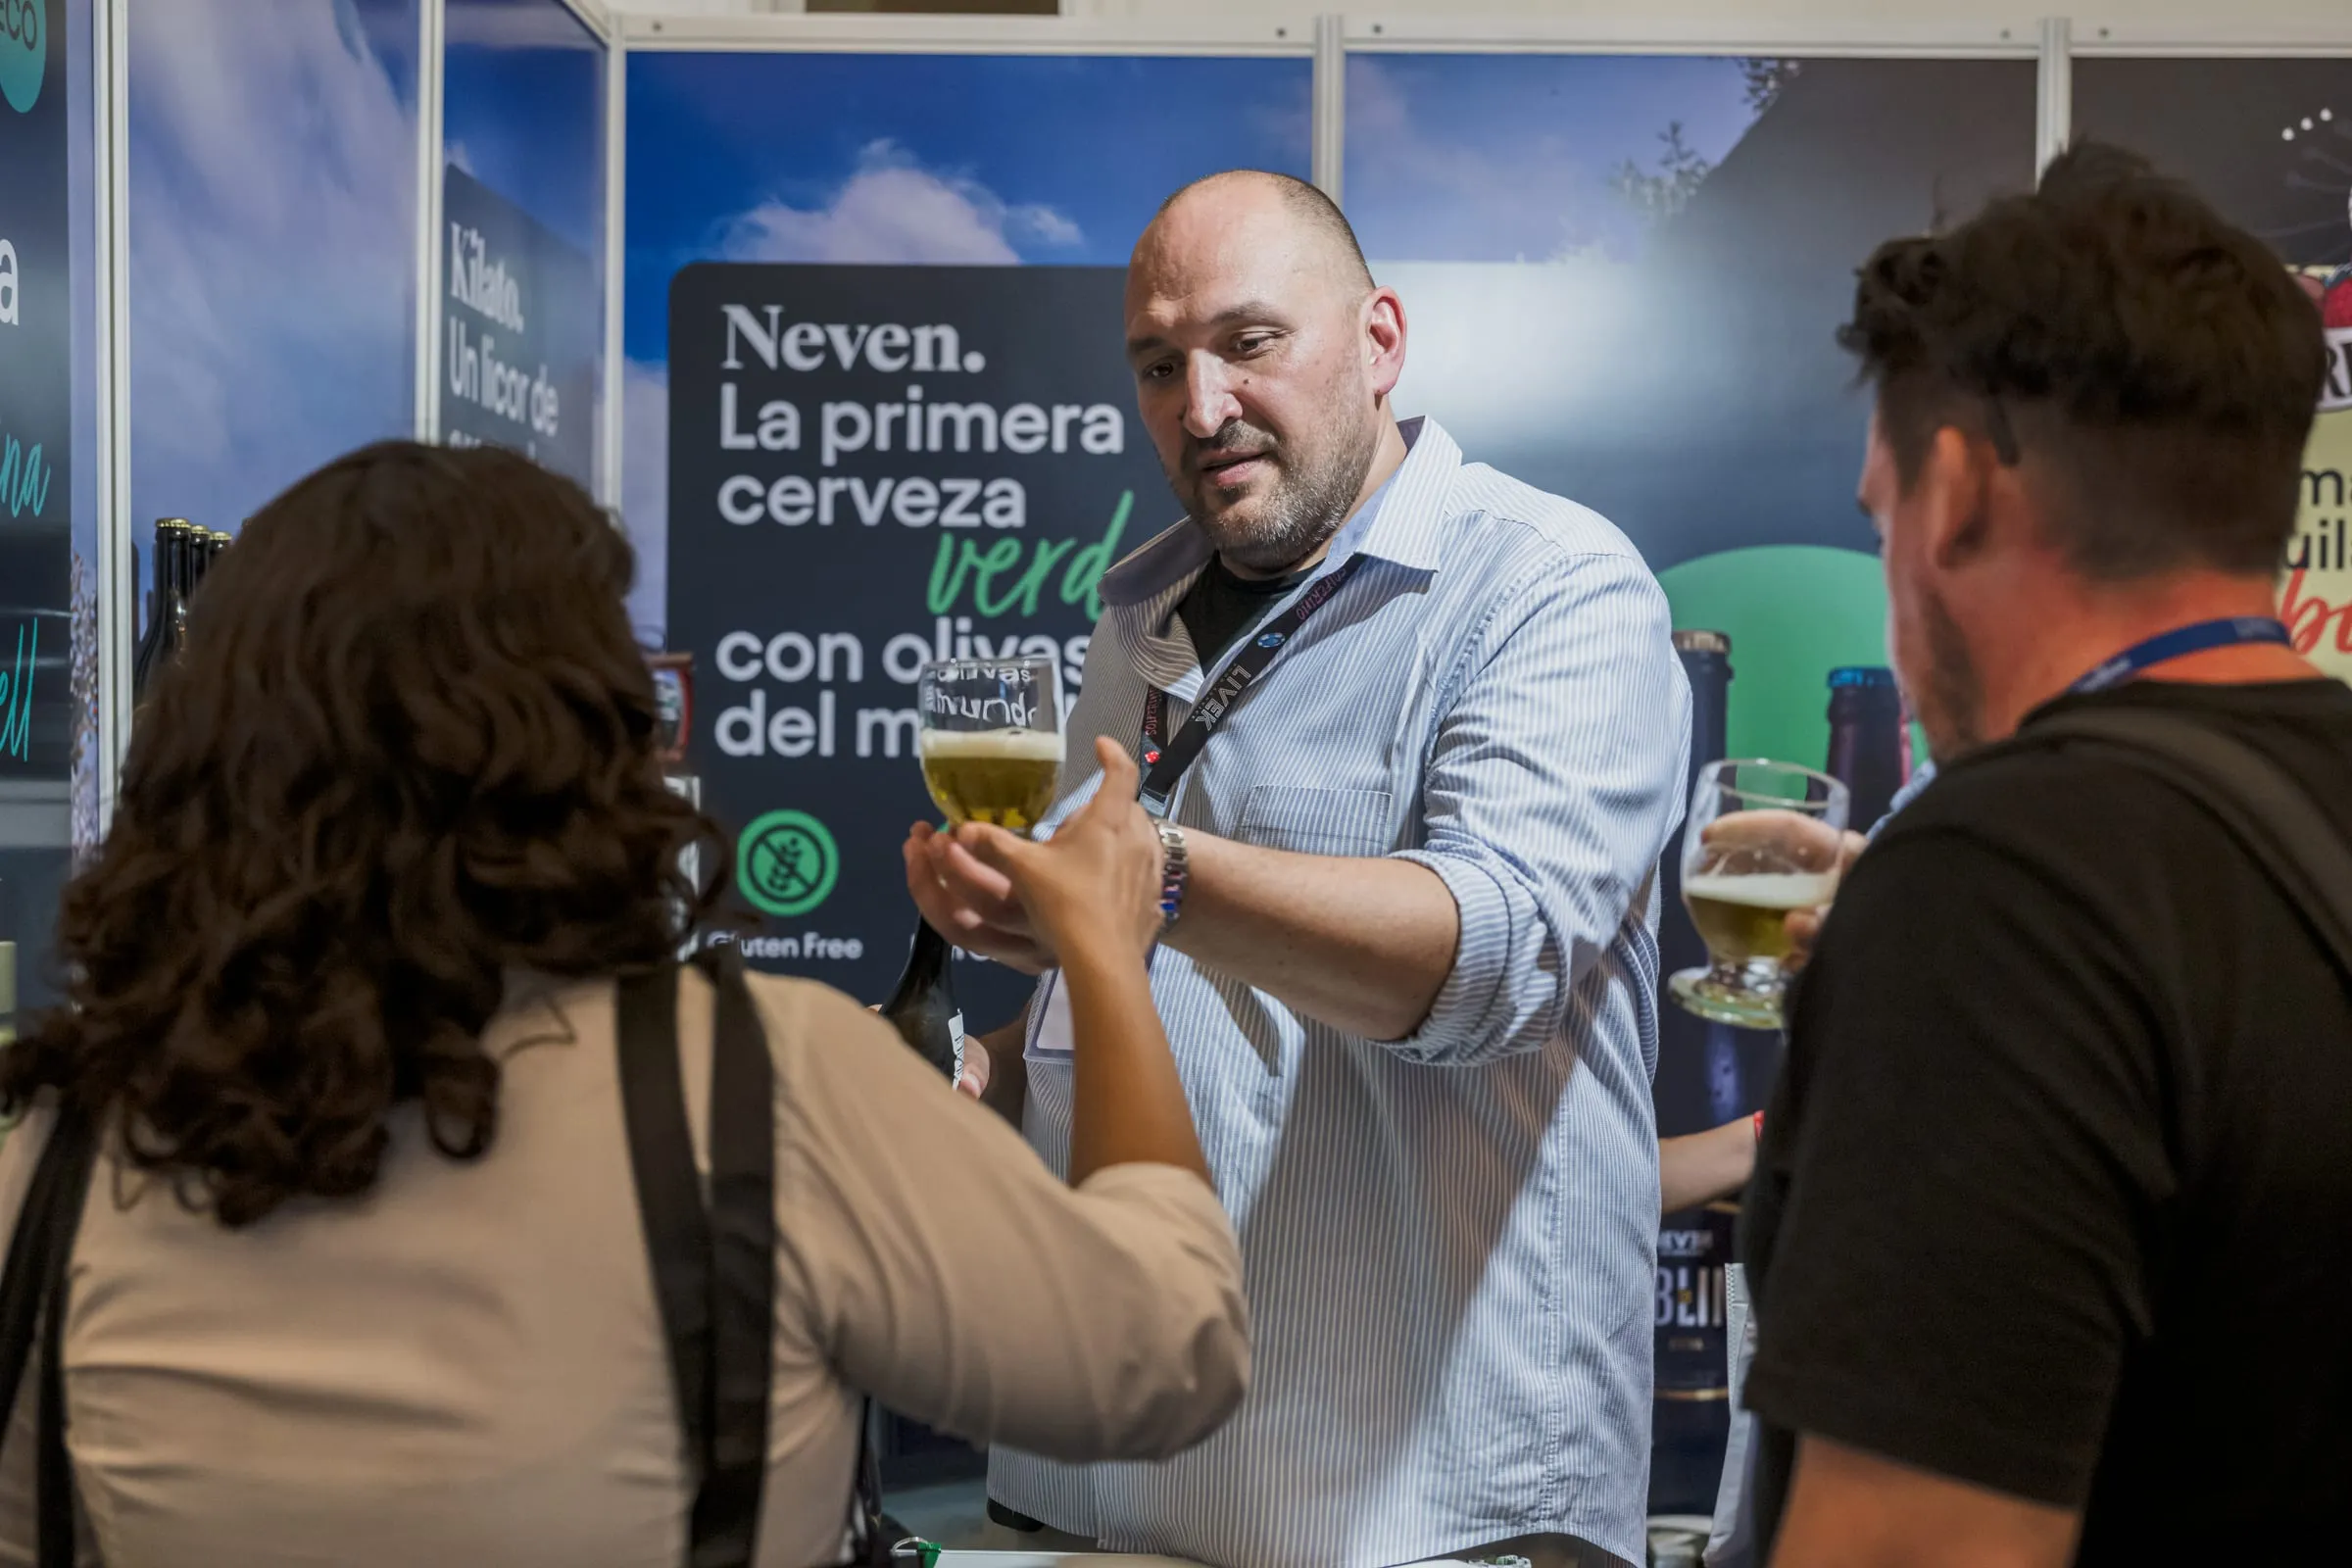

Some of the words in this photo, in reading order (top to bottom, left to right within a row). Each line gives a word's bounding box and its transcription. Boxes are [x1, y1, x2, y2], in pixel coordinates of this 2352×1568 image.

[721, 305, 986, 373] Neven.
[449, 316, 479, 403] Un
[480, 334, 530, 425] licor
[530, 364, 560, 437] de
[720, 383, 801, 451] La
[820, 384, 1125, 467] primera
[717, 474, 1027, 529] cerveza
[927, 489, 1134, 623] verd
[715, 632, 863, 683] con
[714, 688, 835, 757] del
[1195, 664, 1252, 731] LIVEK
[706, 931, 800, 958] Guten
[803, 931, 864, 959] Free
